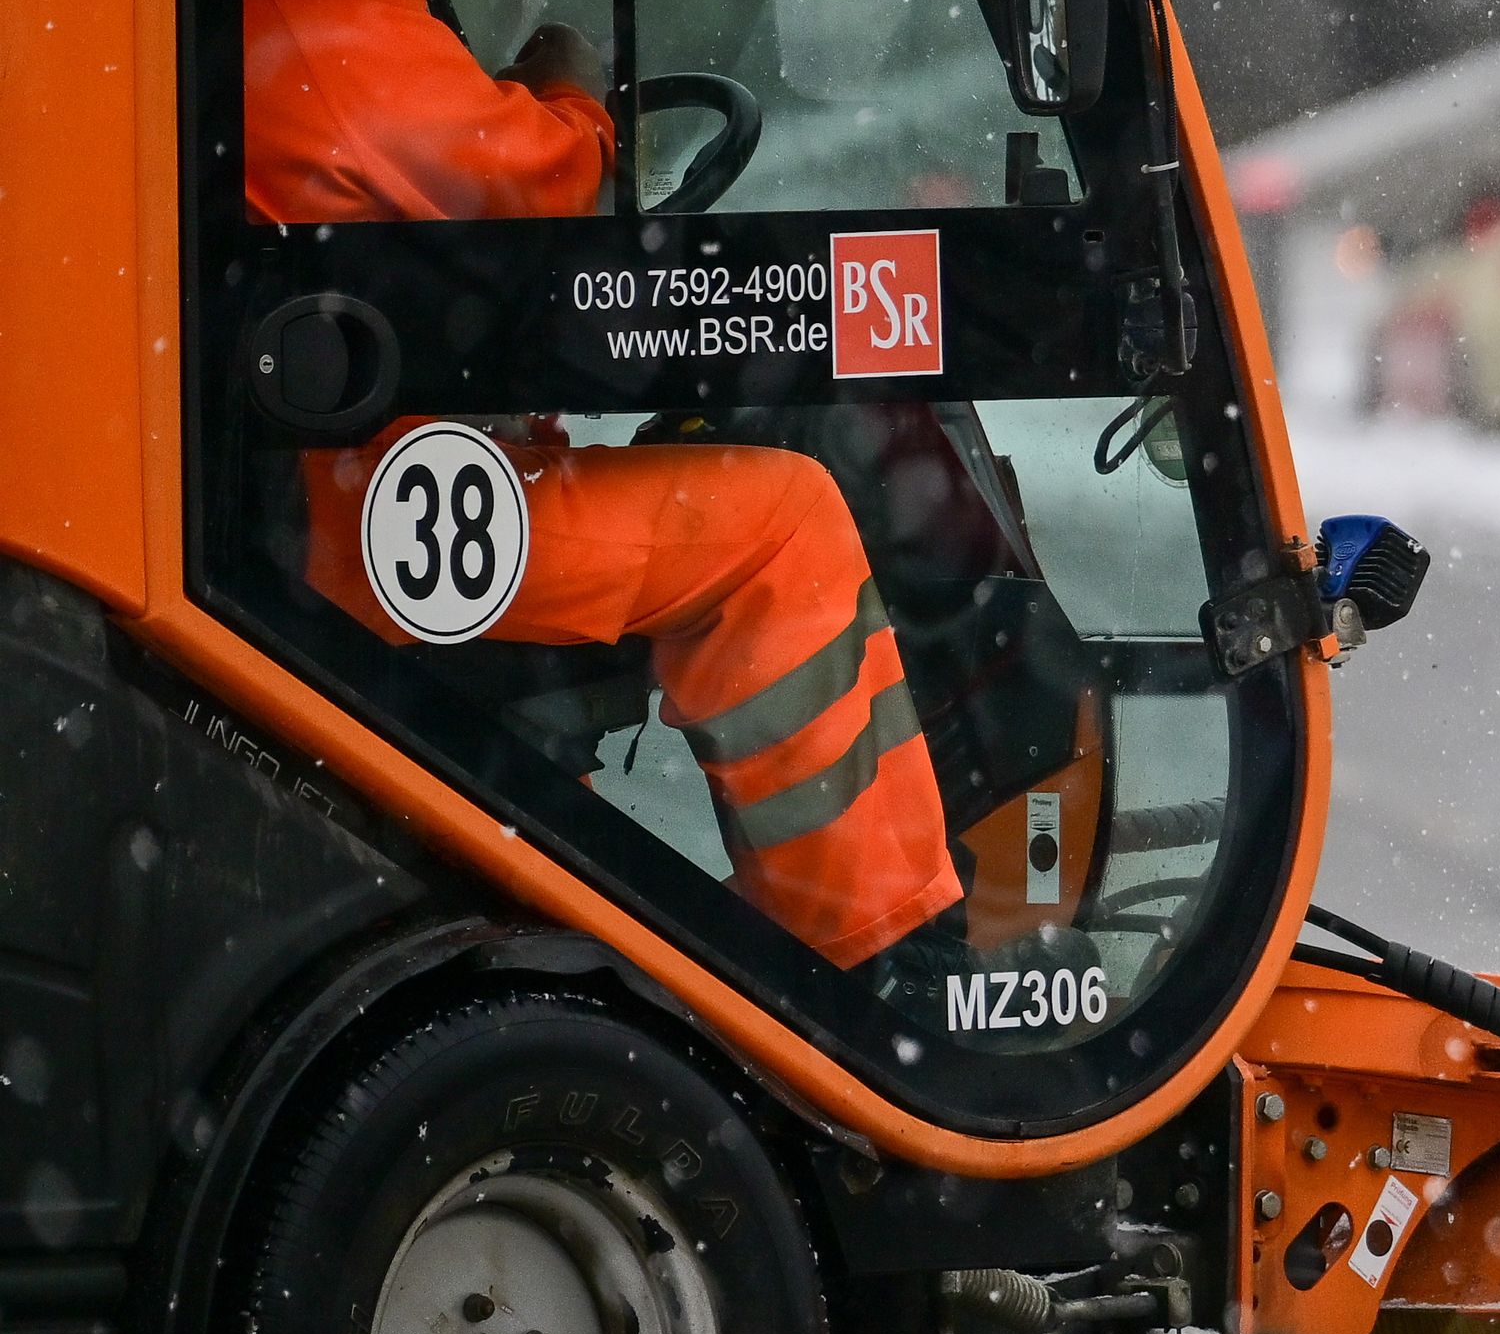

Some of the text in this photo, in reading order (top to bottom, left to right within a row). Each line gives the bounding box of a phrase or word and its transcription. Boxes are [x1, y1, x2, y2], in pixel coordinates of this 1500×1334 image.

[573, 262, 828, 311] 030 7592-4900
[841, 258, 932, 350] BSR
[606, 313, 828, 360] www.BSR.de
[395, 463, 496, 601] 38
[946, 966, 1108, 1032] MZ306
[502, 1091, 739, 1241] FULDA
